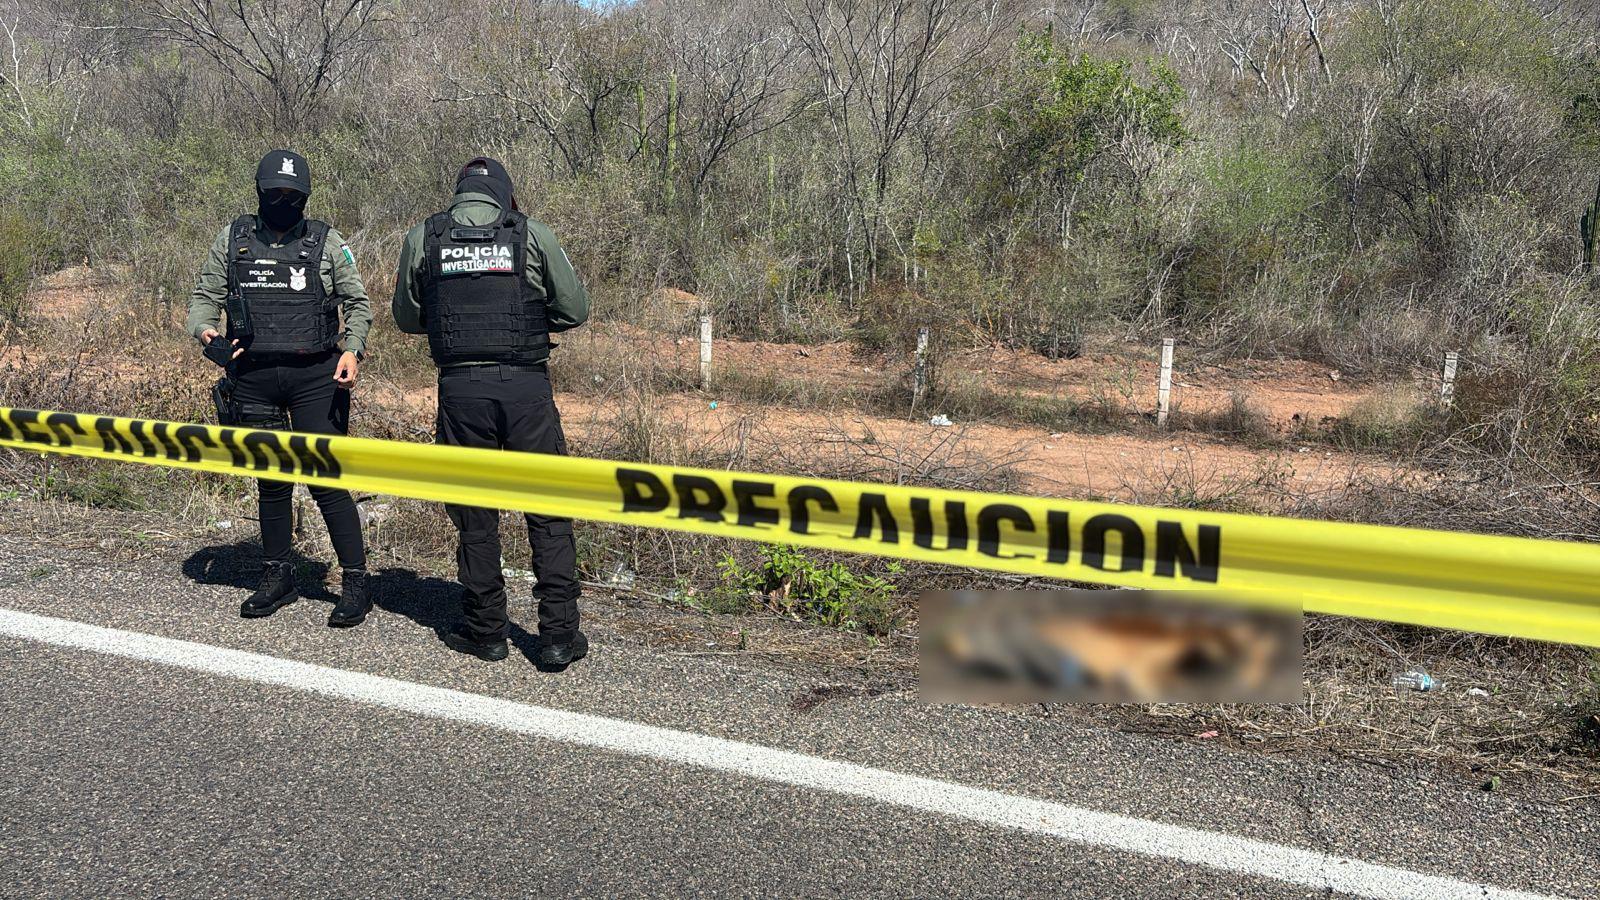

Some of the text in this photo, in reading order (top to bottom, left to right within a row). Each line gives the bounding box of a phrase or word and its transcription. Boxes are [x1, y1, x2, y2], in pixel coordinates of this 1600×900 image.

[441, 244, 511, 259] POLICÍA
[441, 257, 512, 271] INVESTIGACIÓN
[0, 408, 342, 479] ECAUCION
[615, 467, 1221, 583] PRECAUCION
